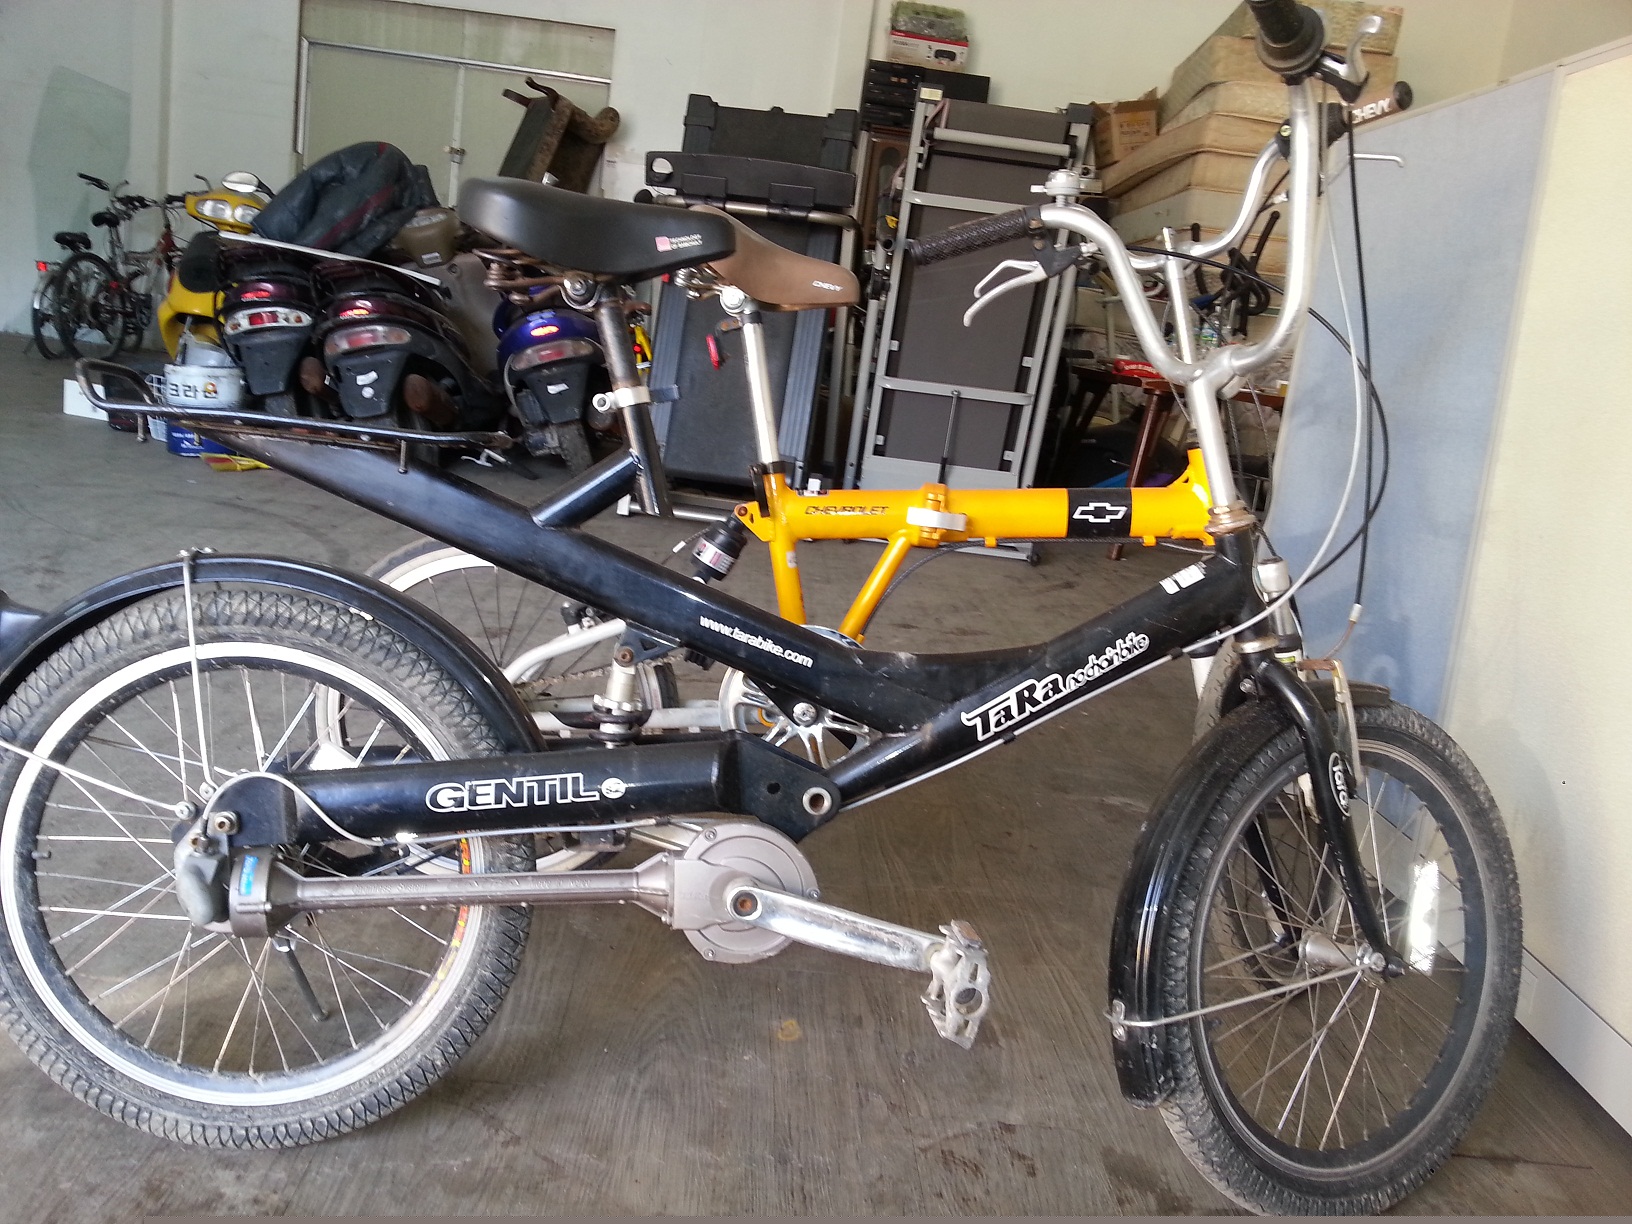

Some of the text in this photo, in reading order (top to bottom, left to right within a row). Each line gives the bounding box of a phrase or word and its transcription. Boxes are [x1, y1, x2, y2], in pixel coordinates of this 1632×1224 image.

[805, 505, 889, 515] CHEVROLET
[700, 615, 814, 668] www.tarabike.com
[425, 772, 600, 813] GENTIL
